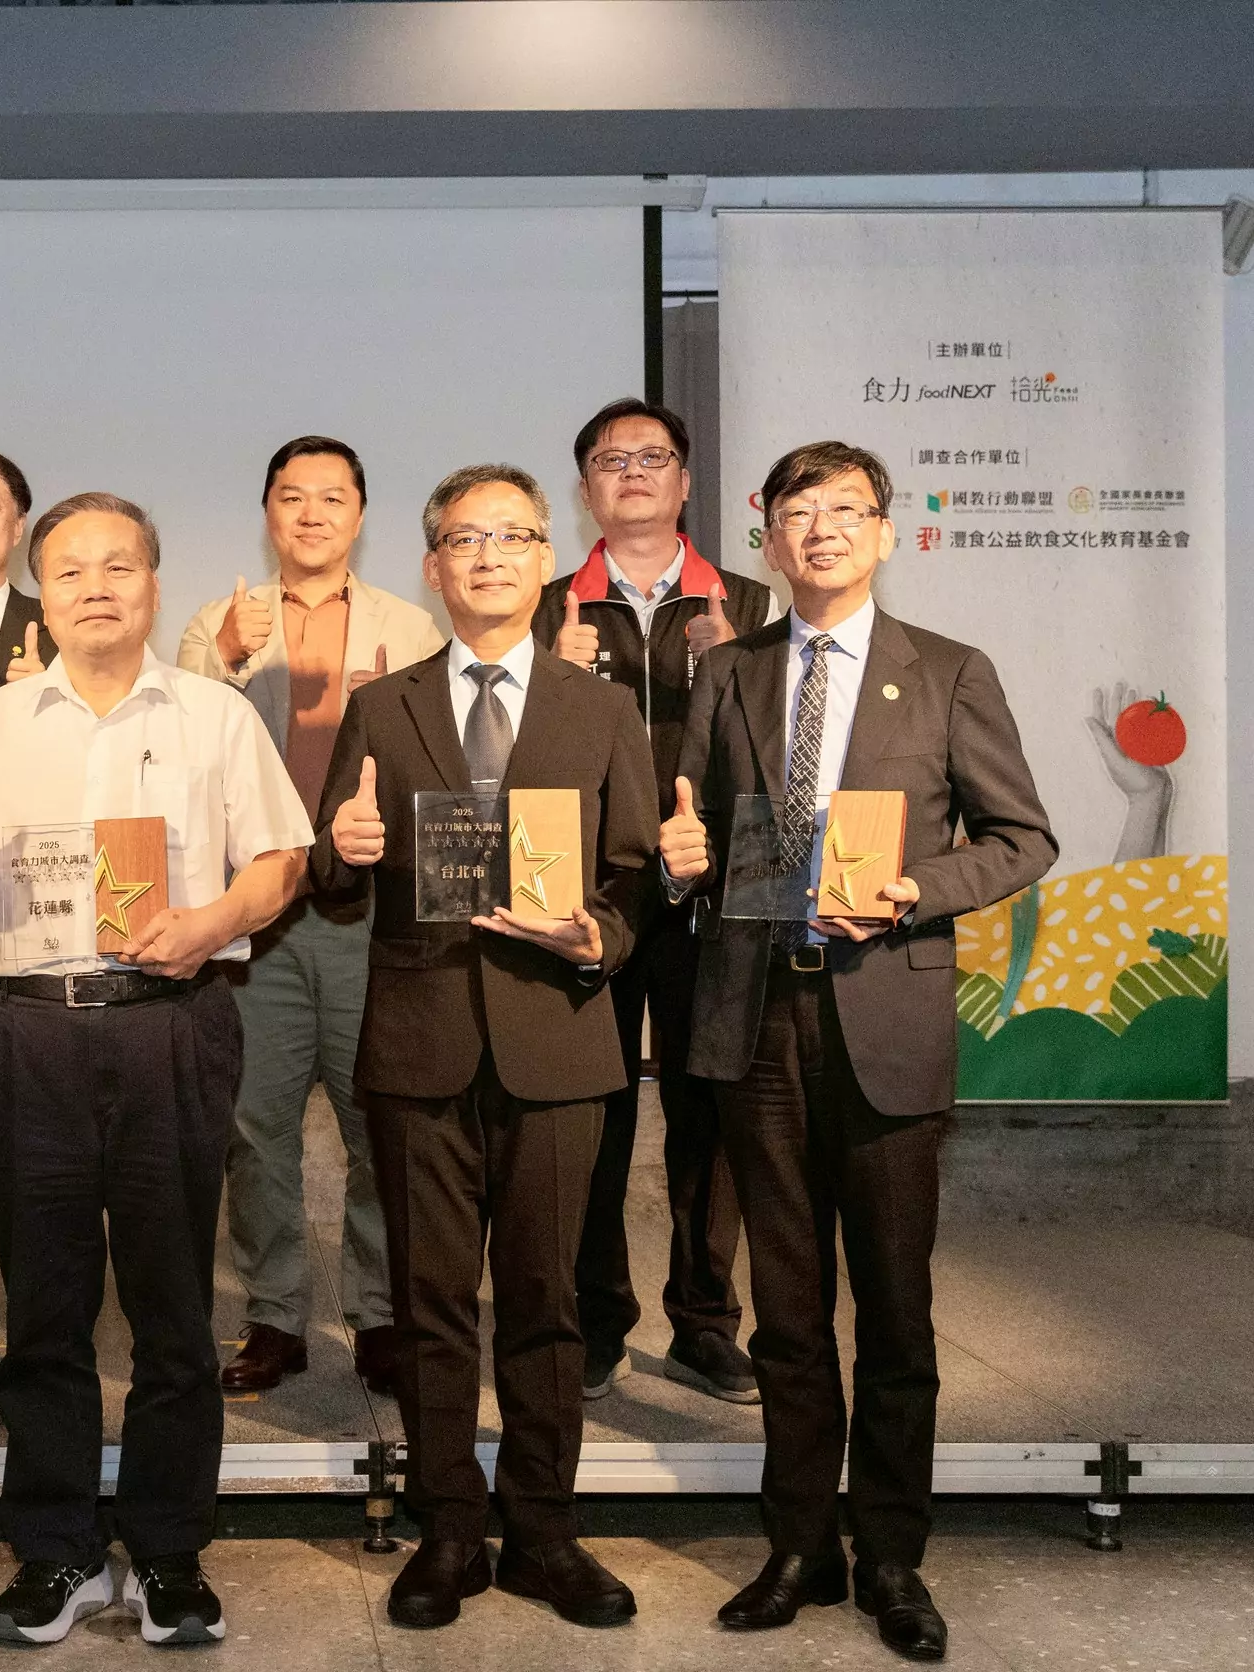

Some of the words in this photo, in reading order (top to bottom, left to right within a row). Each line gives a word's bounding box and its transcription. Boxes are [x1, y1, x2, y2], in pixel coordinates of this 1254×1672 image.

[936, 342, 1003, 358] 主辦單位
[862, 377, 910, 403] 食力
[916, 384, 997, 402] foodNEXT
[918, 449, 1020, 465] 調查合作單位
[952, 491, 1053, 506] 國教行動聯盟
[950, 530, 1190, 548] 灃食公益飲食文化教育基金會
[452, 808, 474, 816] 2025
[39, 841, 60, 850] 2025
[441, 865, 486, 879] 台北市
[28, 899, 74, 915] 花蓮縣
